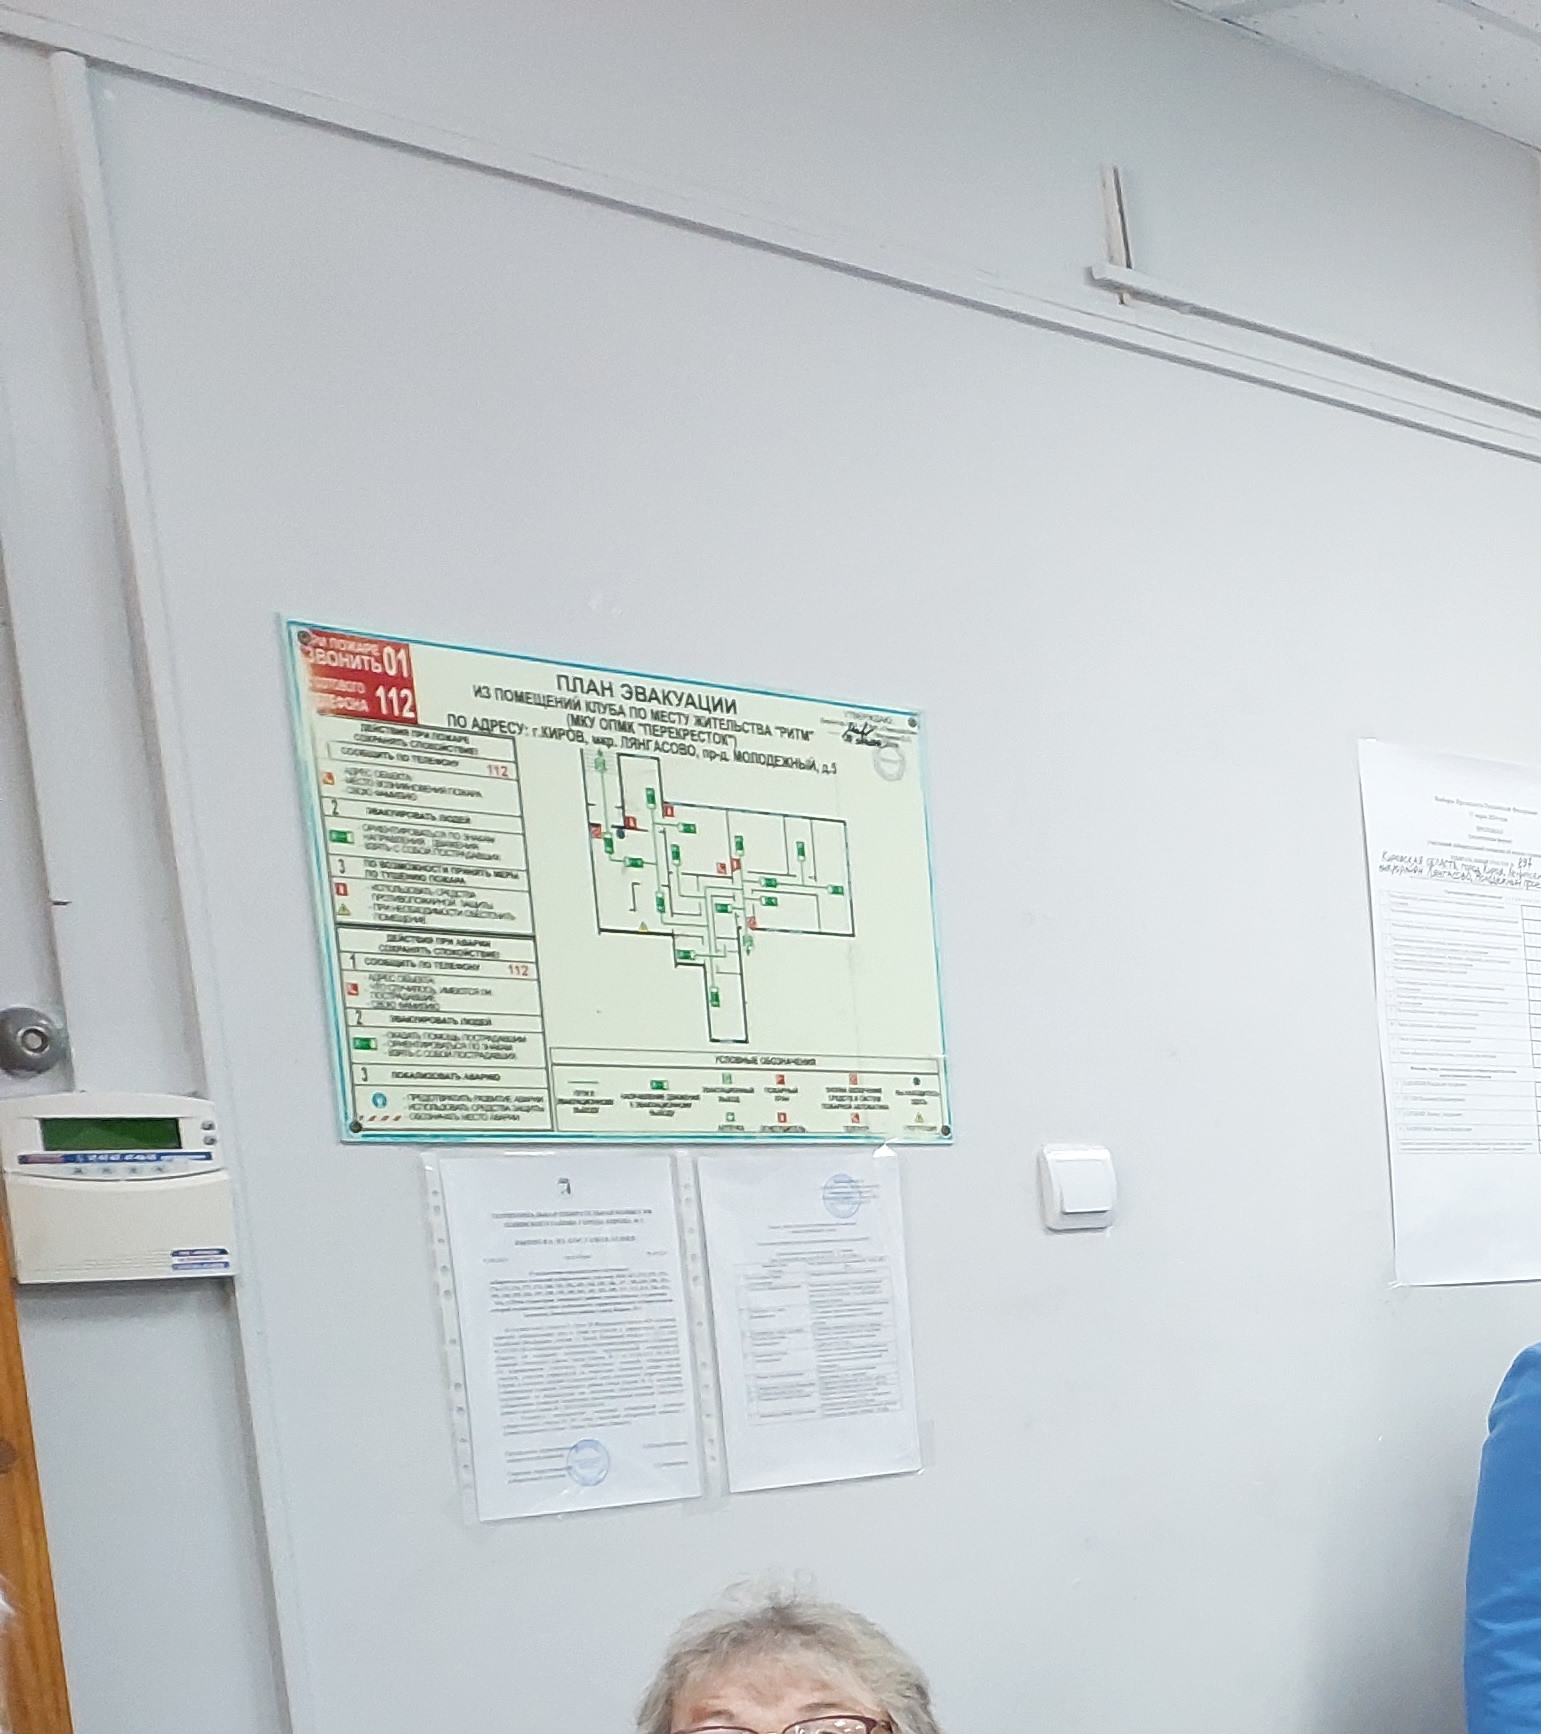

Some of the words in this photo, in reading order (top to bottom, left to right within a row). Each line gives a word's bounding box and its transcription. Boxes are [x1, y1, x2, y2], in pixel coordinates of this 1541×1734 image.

[300, 645, 382, 673] ЗВОНИТЬ
[383, 645, 409, 678] 01
[375, 685, 416, 718] 112
[556, 674, 614, 698] ПЛАН
[620, 683, 737, 715] ЭВАКУАЦИИ
[473, 685, 491, 699] ИЗ
[495, 687, 582, 711] ПОМЕЩЕНИЙ
[585, 700, 626, 717] КЛУБА
[629, 706, 647, 720] ПО
[651, 709, 690, 726] МЕСТУ
[694, 714, 773, 737] ЖИТЕЛЬСТВА
[448, 714, 468, 728] ПО
[471, 716, 529, 735] АДРЕСУ:
[599, 719, 636, 734] ОПМК
[487, 764, 509, 778] 112
[331, 800, 339, 816] 2
[338, 858, 346, 874] 3
[349, 954, 356, 969] 1
[508, 965, 529, 976] 112
[356, 1010, 363, 1025] 2
[361, 1067, 367, 1081] 3
